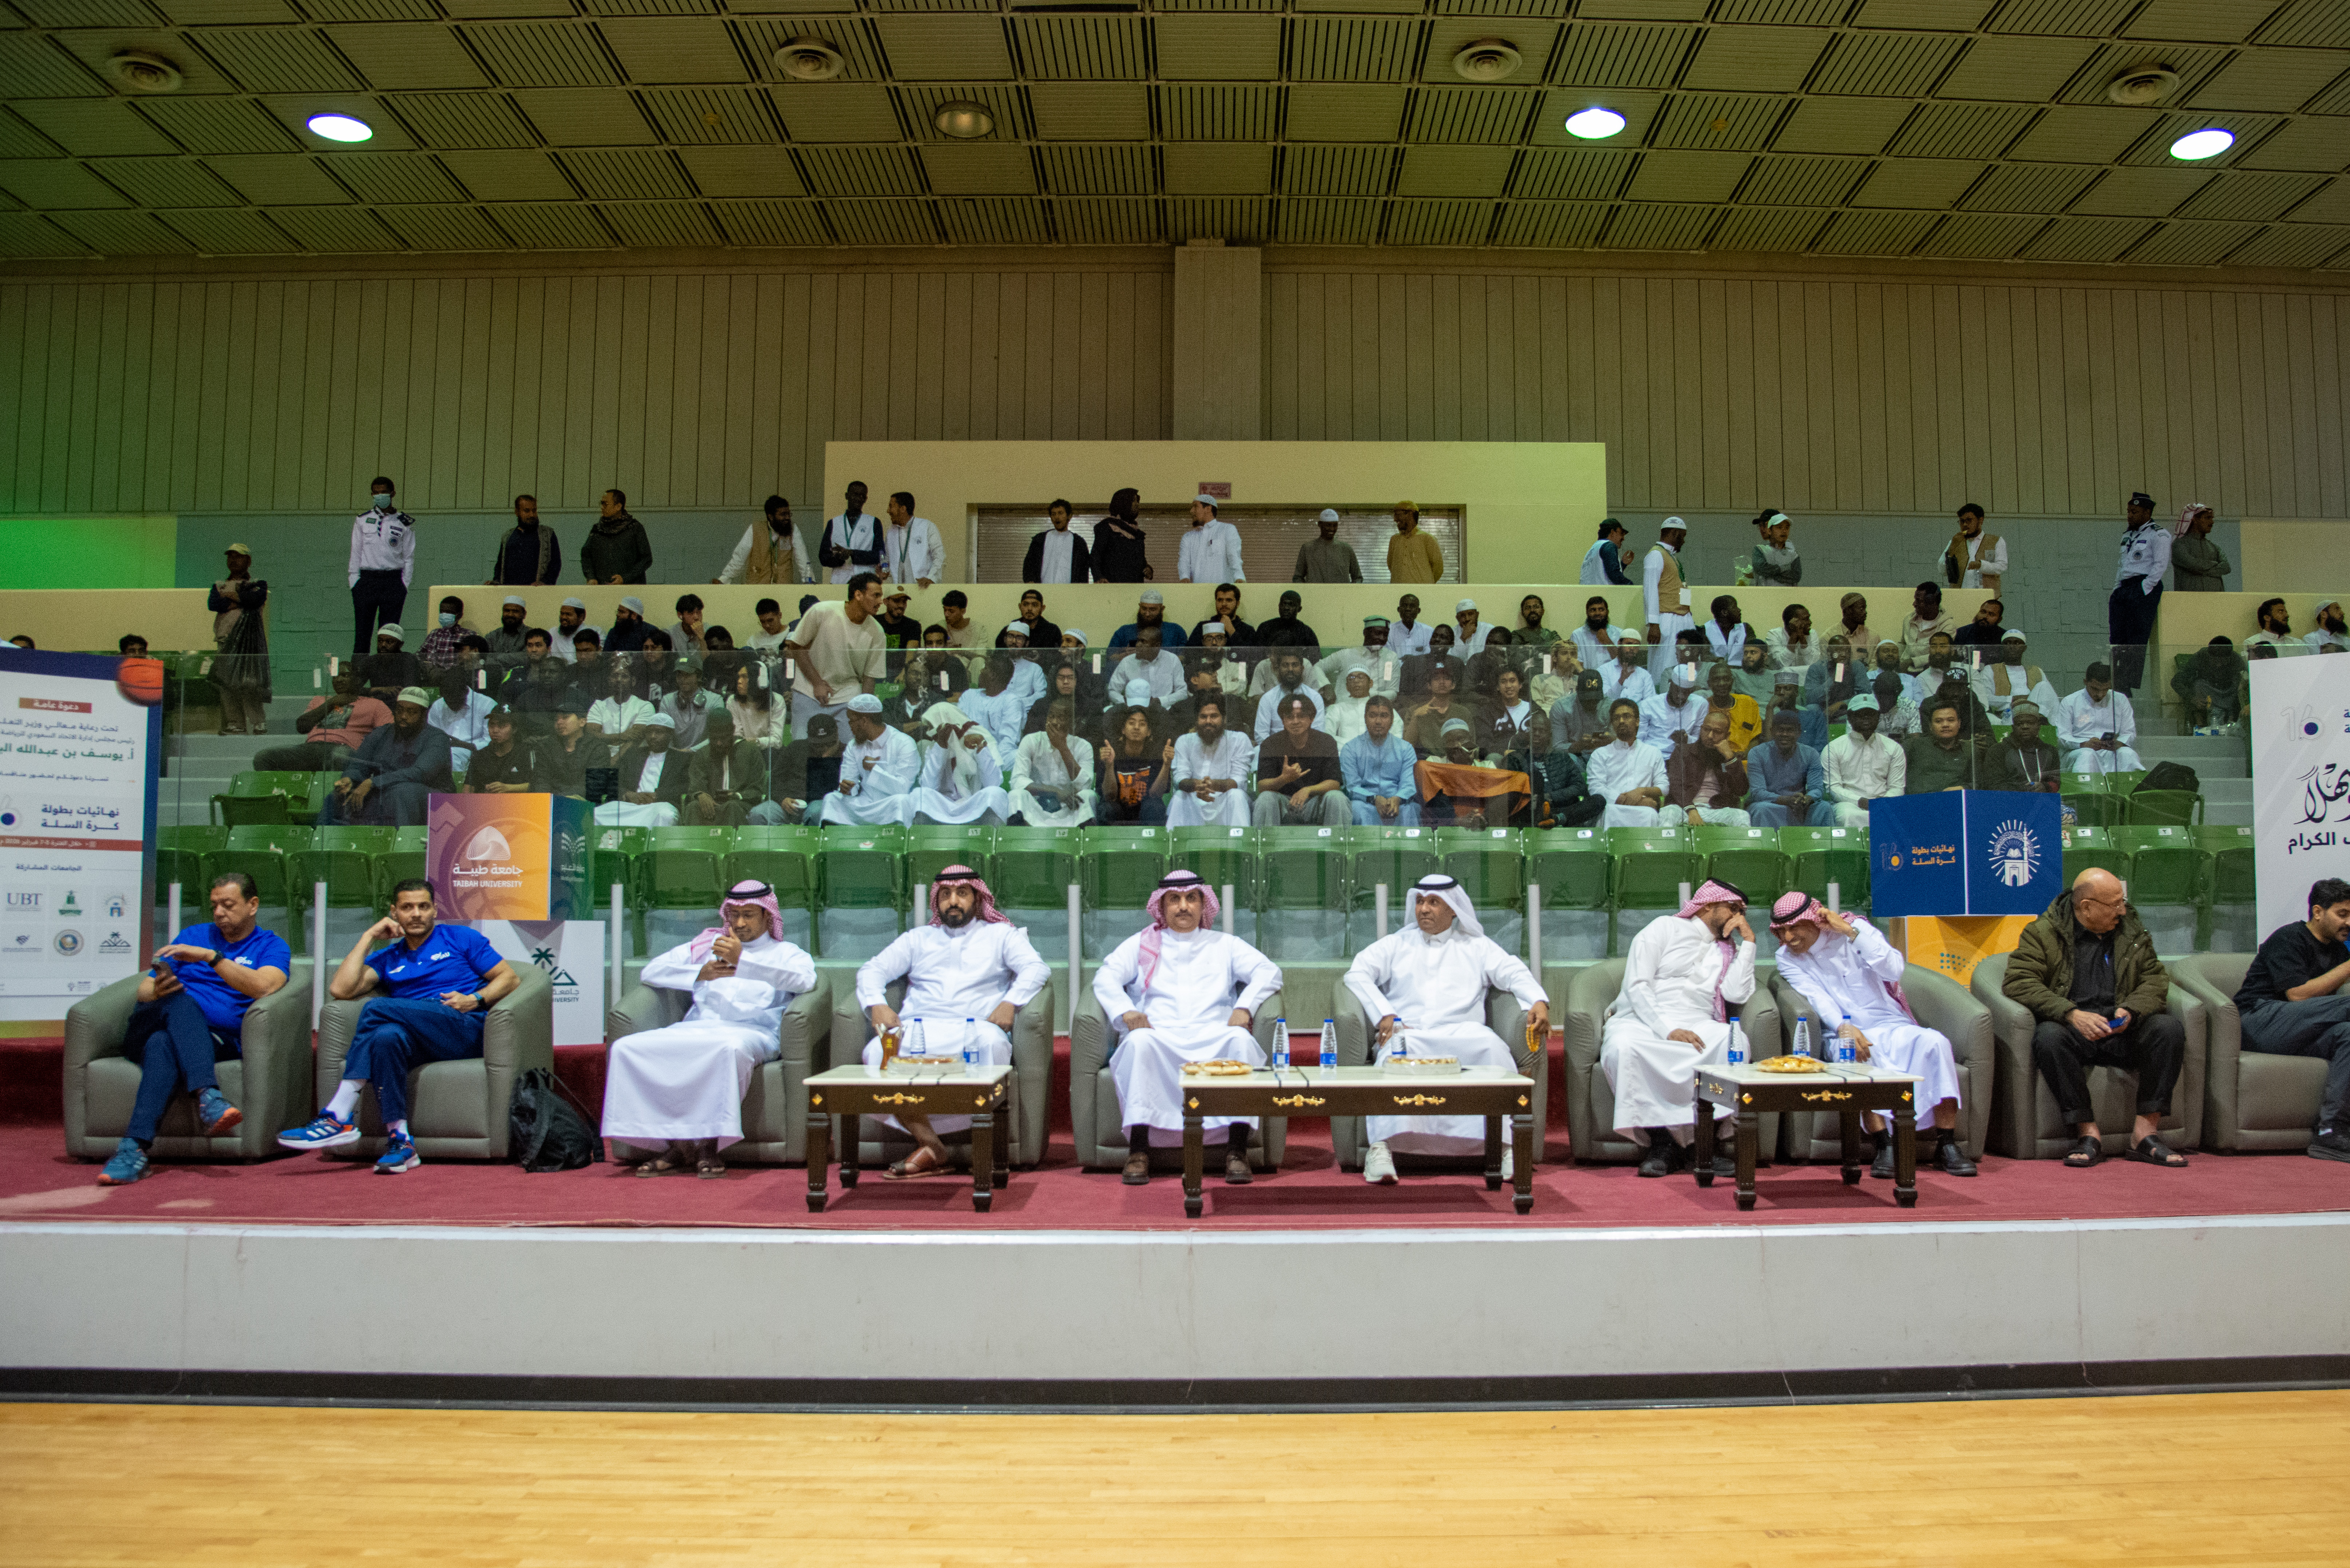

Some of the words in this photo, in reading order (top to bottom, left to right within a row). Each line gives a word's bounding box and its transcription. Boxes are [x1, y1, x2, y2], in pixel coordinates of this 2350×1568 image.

[33, 698, 56, 708] عامة
[59, 701, 79, 711] دعوة
[16, 744, 58, 757] عبدالله
[62, 749, 77, 759] بن
[80, 748, 123, 761] يوسف
[42, 804, 72, 816] بطولة
[76, 806, 119, 818] نهائيات
[41, 819, 82, 829] السلة
[86, 820, 119, 832] كرة
[1930, 844, 1955, 854] نهائيات
[2288, 832, 2335, 854] الكرام
[1912, 846, 1930, 855] بطولة
[1912, 857, 1935, 865] السلة
[1936, 856, 1956, 866] كرة
[453, 863, 489, 876] طيبة
[490, 863, 524, 878] جامعة
[7, 892, 43, 905] UBT
